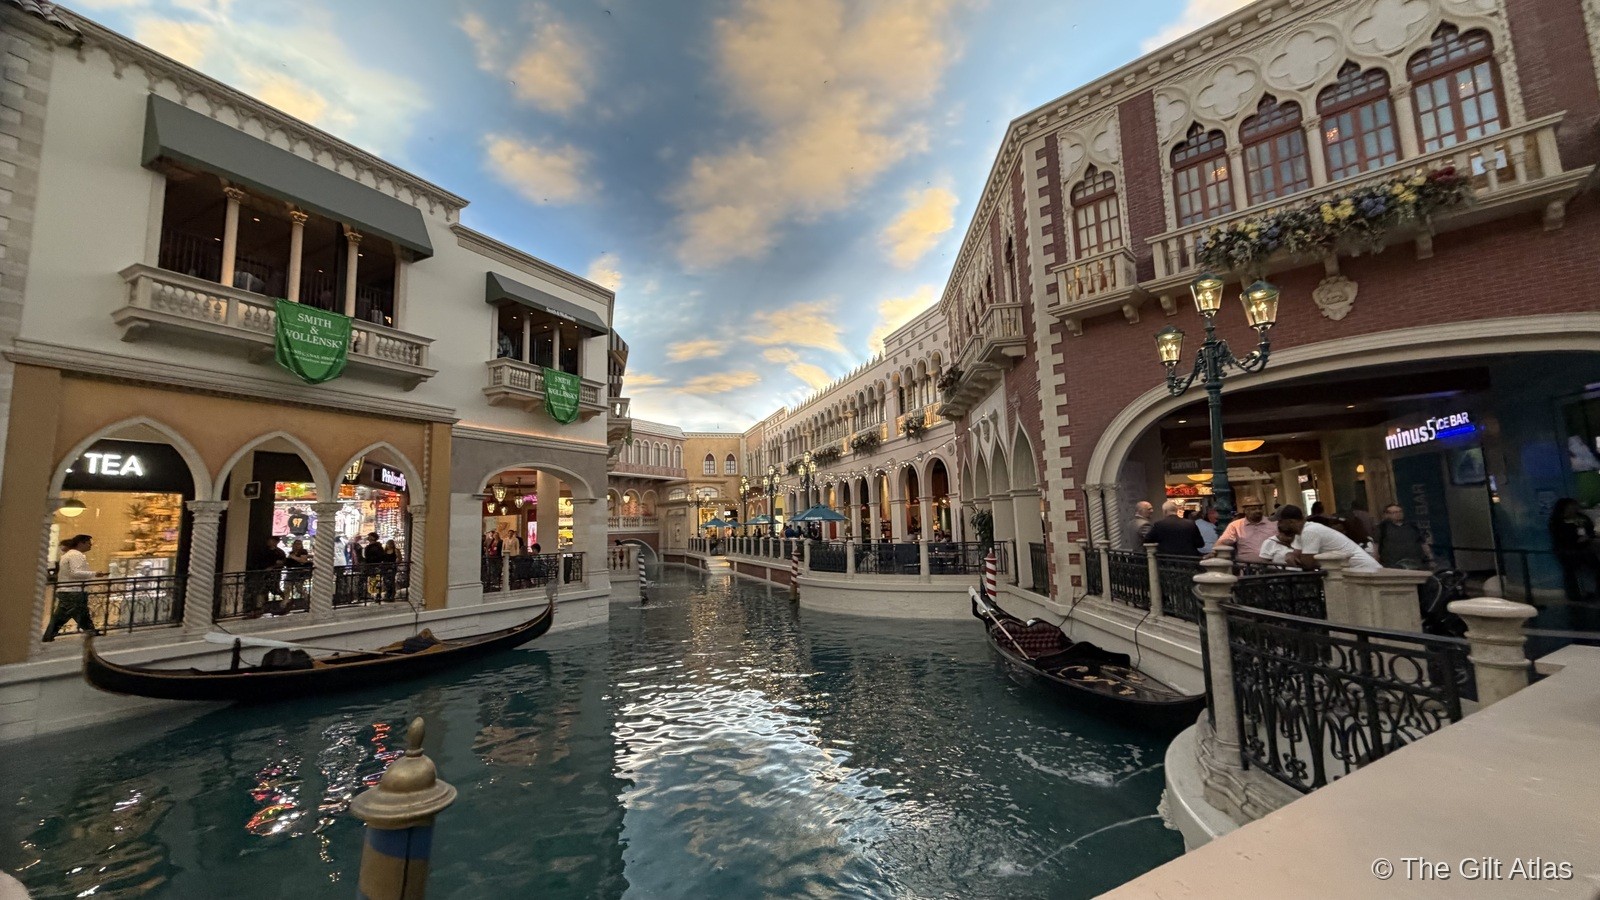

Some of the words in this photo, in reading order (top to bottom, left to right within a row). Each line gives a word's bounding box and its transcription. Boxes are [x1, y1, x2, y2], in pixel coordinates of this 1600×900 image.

[298, 313, 332, 328] SMITH
[310, 326, 319, 335] &
[1436, 417, 1450, 430] ICE
[1449, 411, 1470, 427] BAR
[84, 452, 143, 477] TEA
